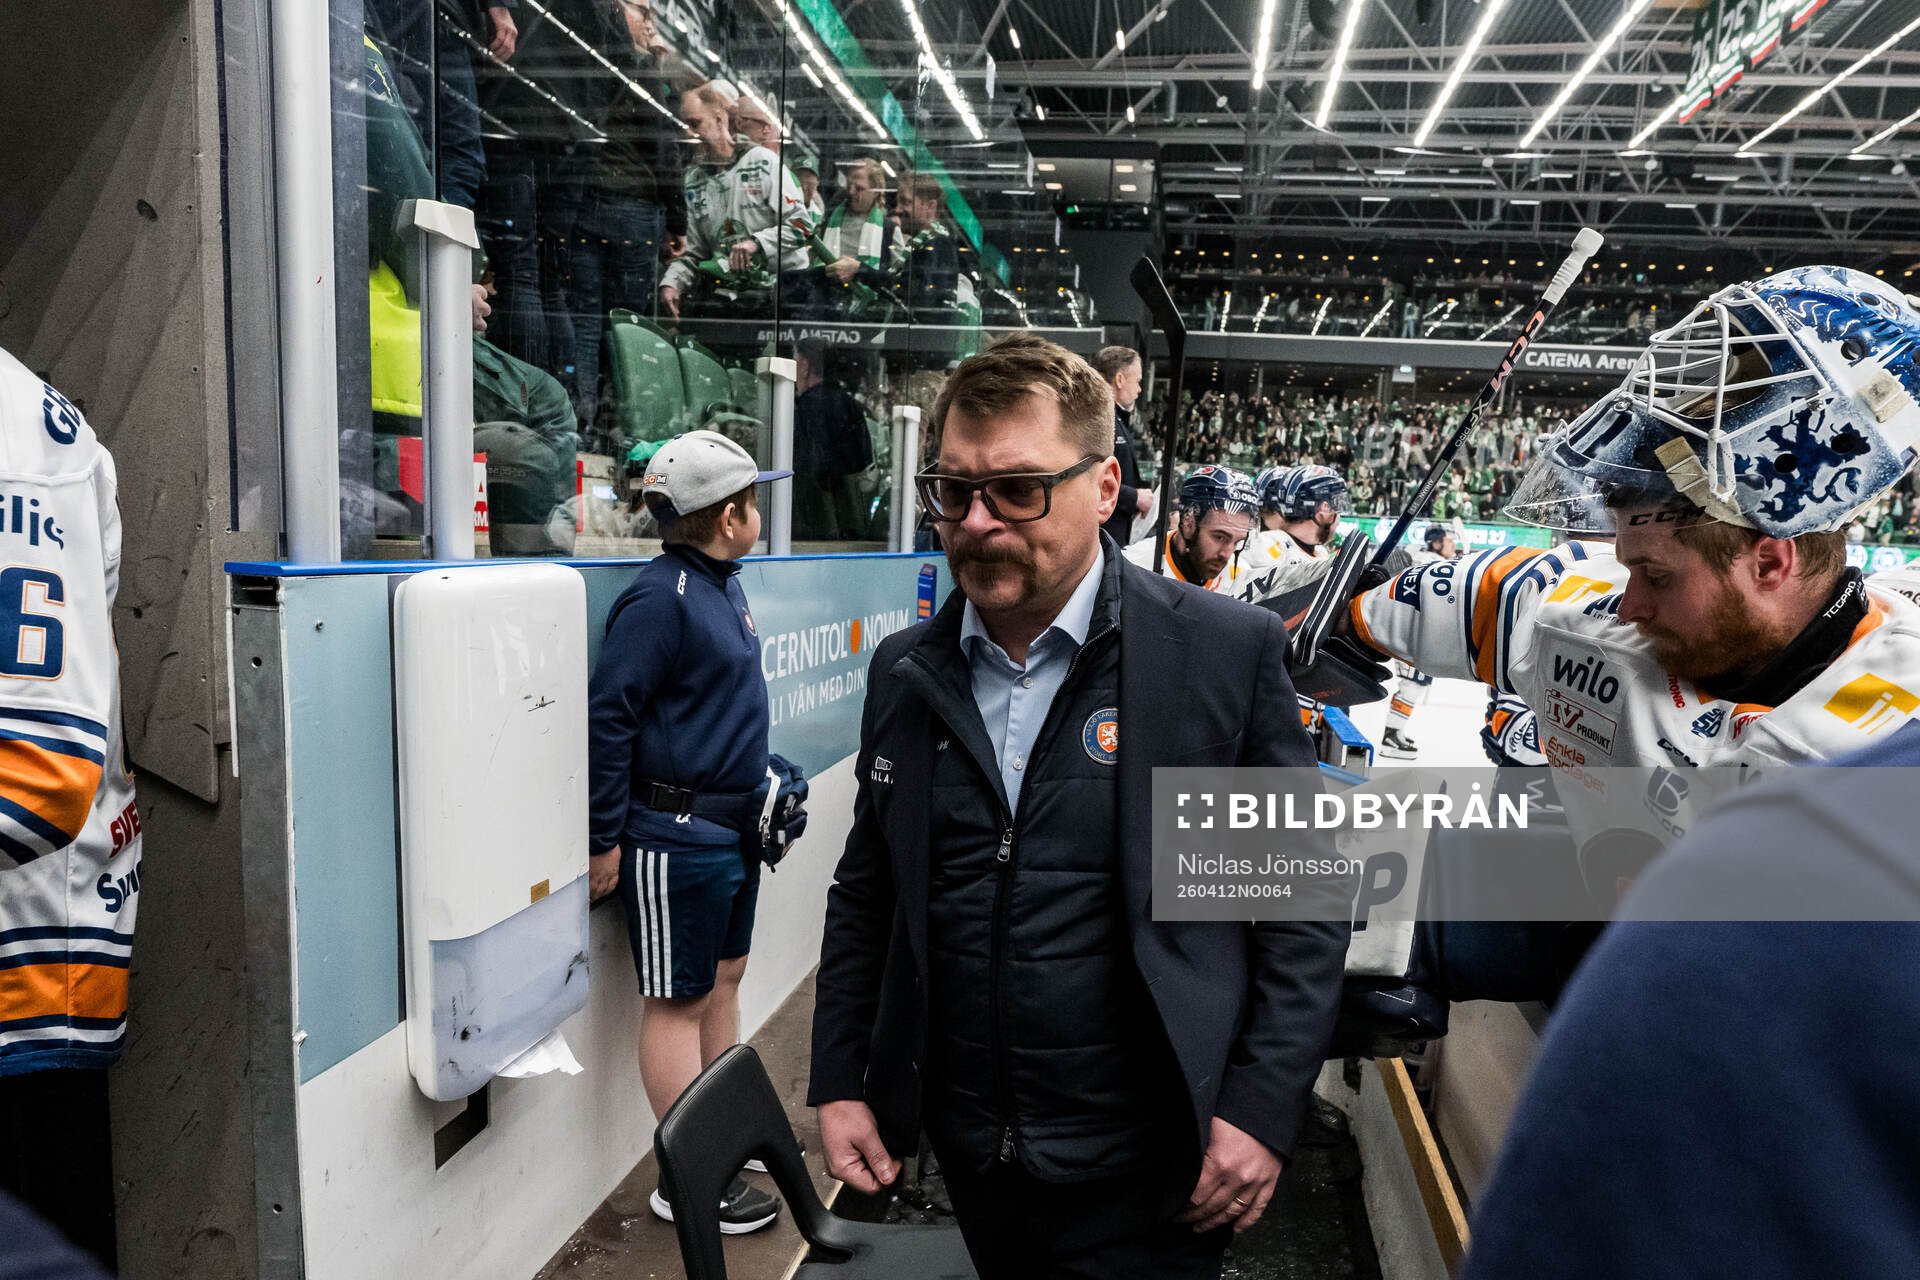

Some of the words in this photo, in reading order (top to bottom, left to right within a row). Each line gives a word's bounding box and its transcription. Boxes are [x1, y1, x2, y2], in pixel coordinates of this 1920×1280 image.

[1490, 310, 1545, 393] CCM
[1525, 352, 1592, 369] CATENA
[1403, 562, 1424, 597] EX
[0, 564, 66, 681] 6
[761, 621, 848, 682] CERNITOL
[788, 683, 815, 719] VÄN
[819, 672, 843, 707] MED
[846, 667, 865, 696] DIN
[1554, 654, 1619, 704] wilo
[1548, 736, 1585, 765] Enkla
[1577, 723, 1611, 750] PRODUKT
